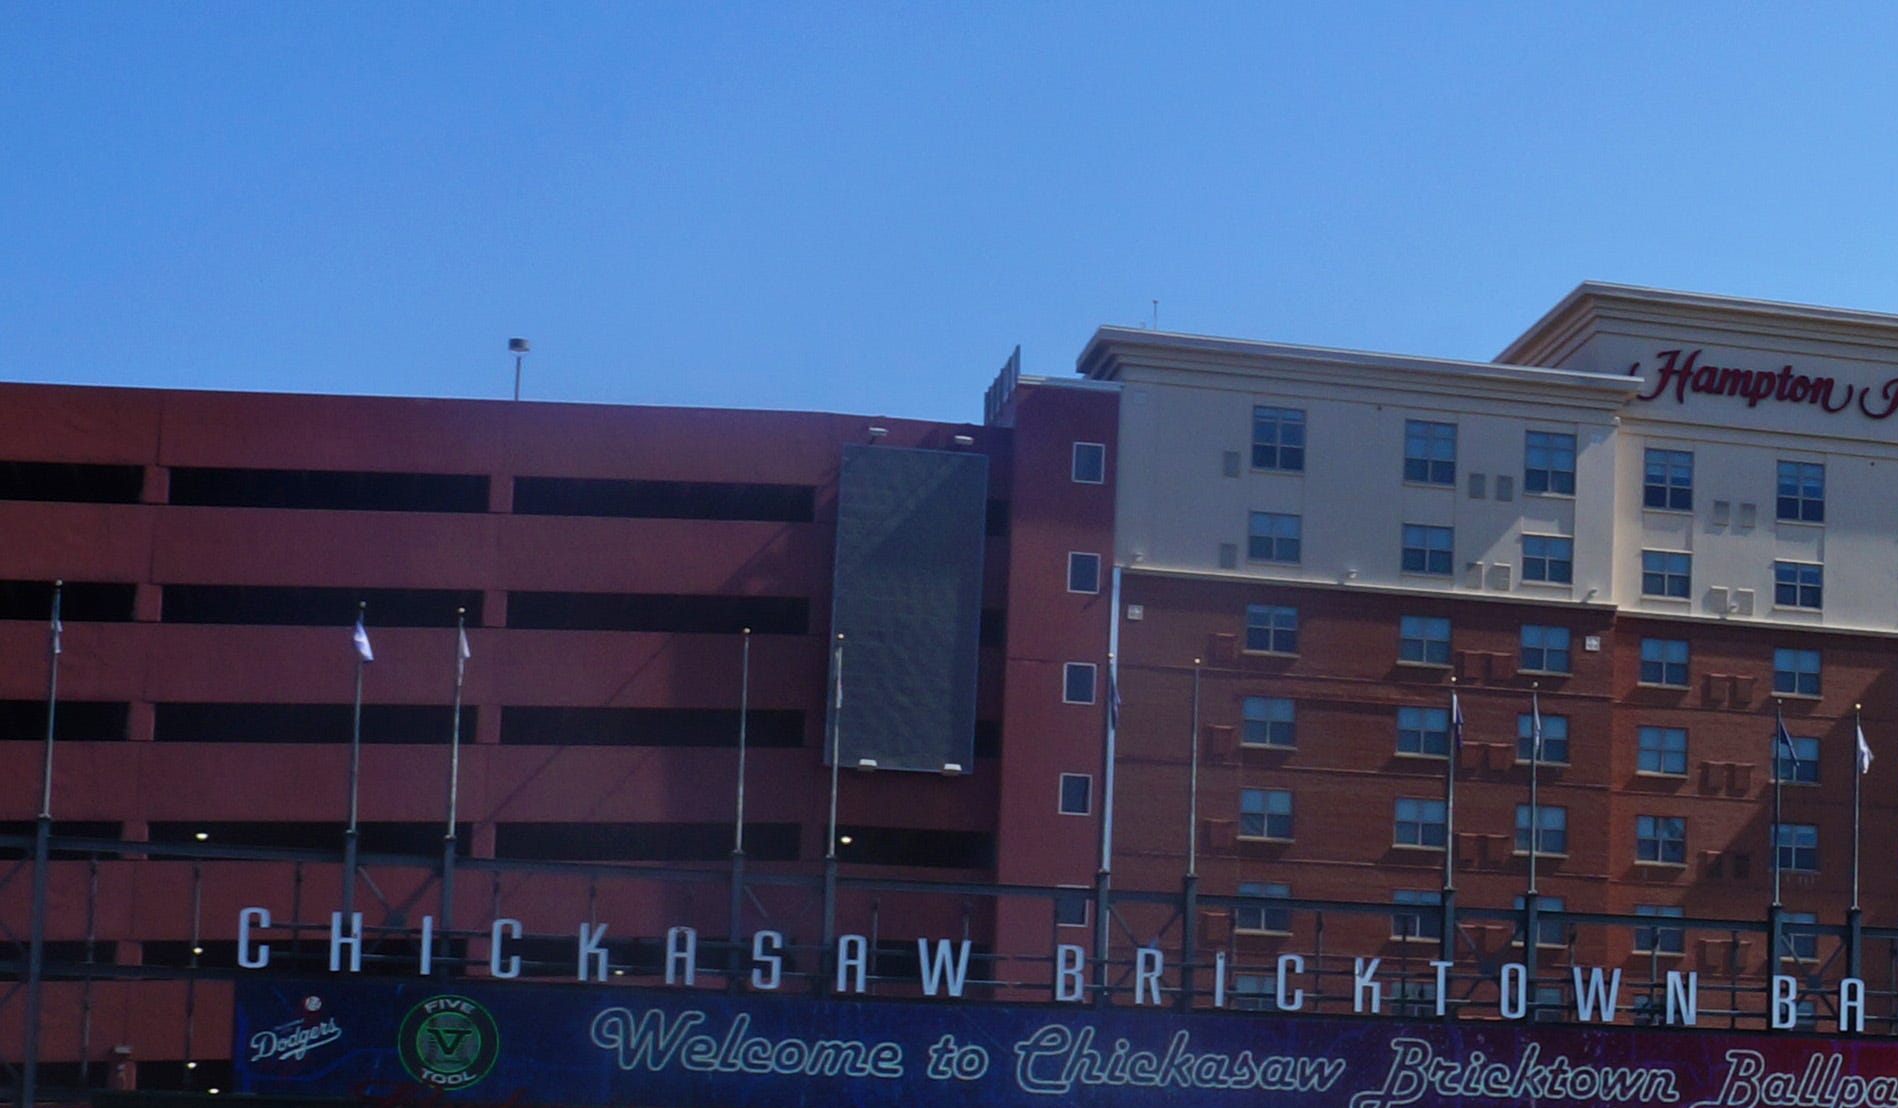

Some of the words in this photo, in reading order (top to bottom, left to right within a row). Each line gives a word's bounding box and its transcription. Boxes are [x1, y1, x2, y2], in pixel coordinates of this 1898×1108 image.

[1630, 349, 1854, 412] Hampton
[238, 906, 972, 996] CHICKASAW
[1056, 944, 1698, 1026] BRICKTOWN
[424, 998, 477, 1015] FIVE
[250, 1017, 342, 1062] Dodgers
[591, 1007, 904, 1078] Welcome
[926, 1033, 989, 1080] to
[1014, 1023, 1346, 1094] Chickasaw
[420, 1066, 478, 1085] TOOL
